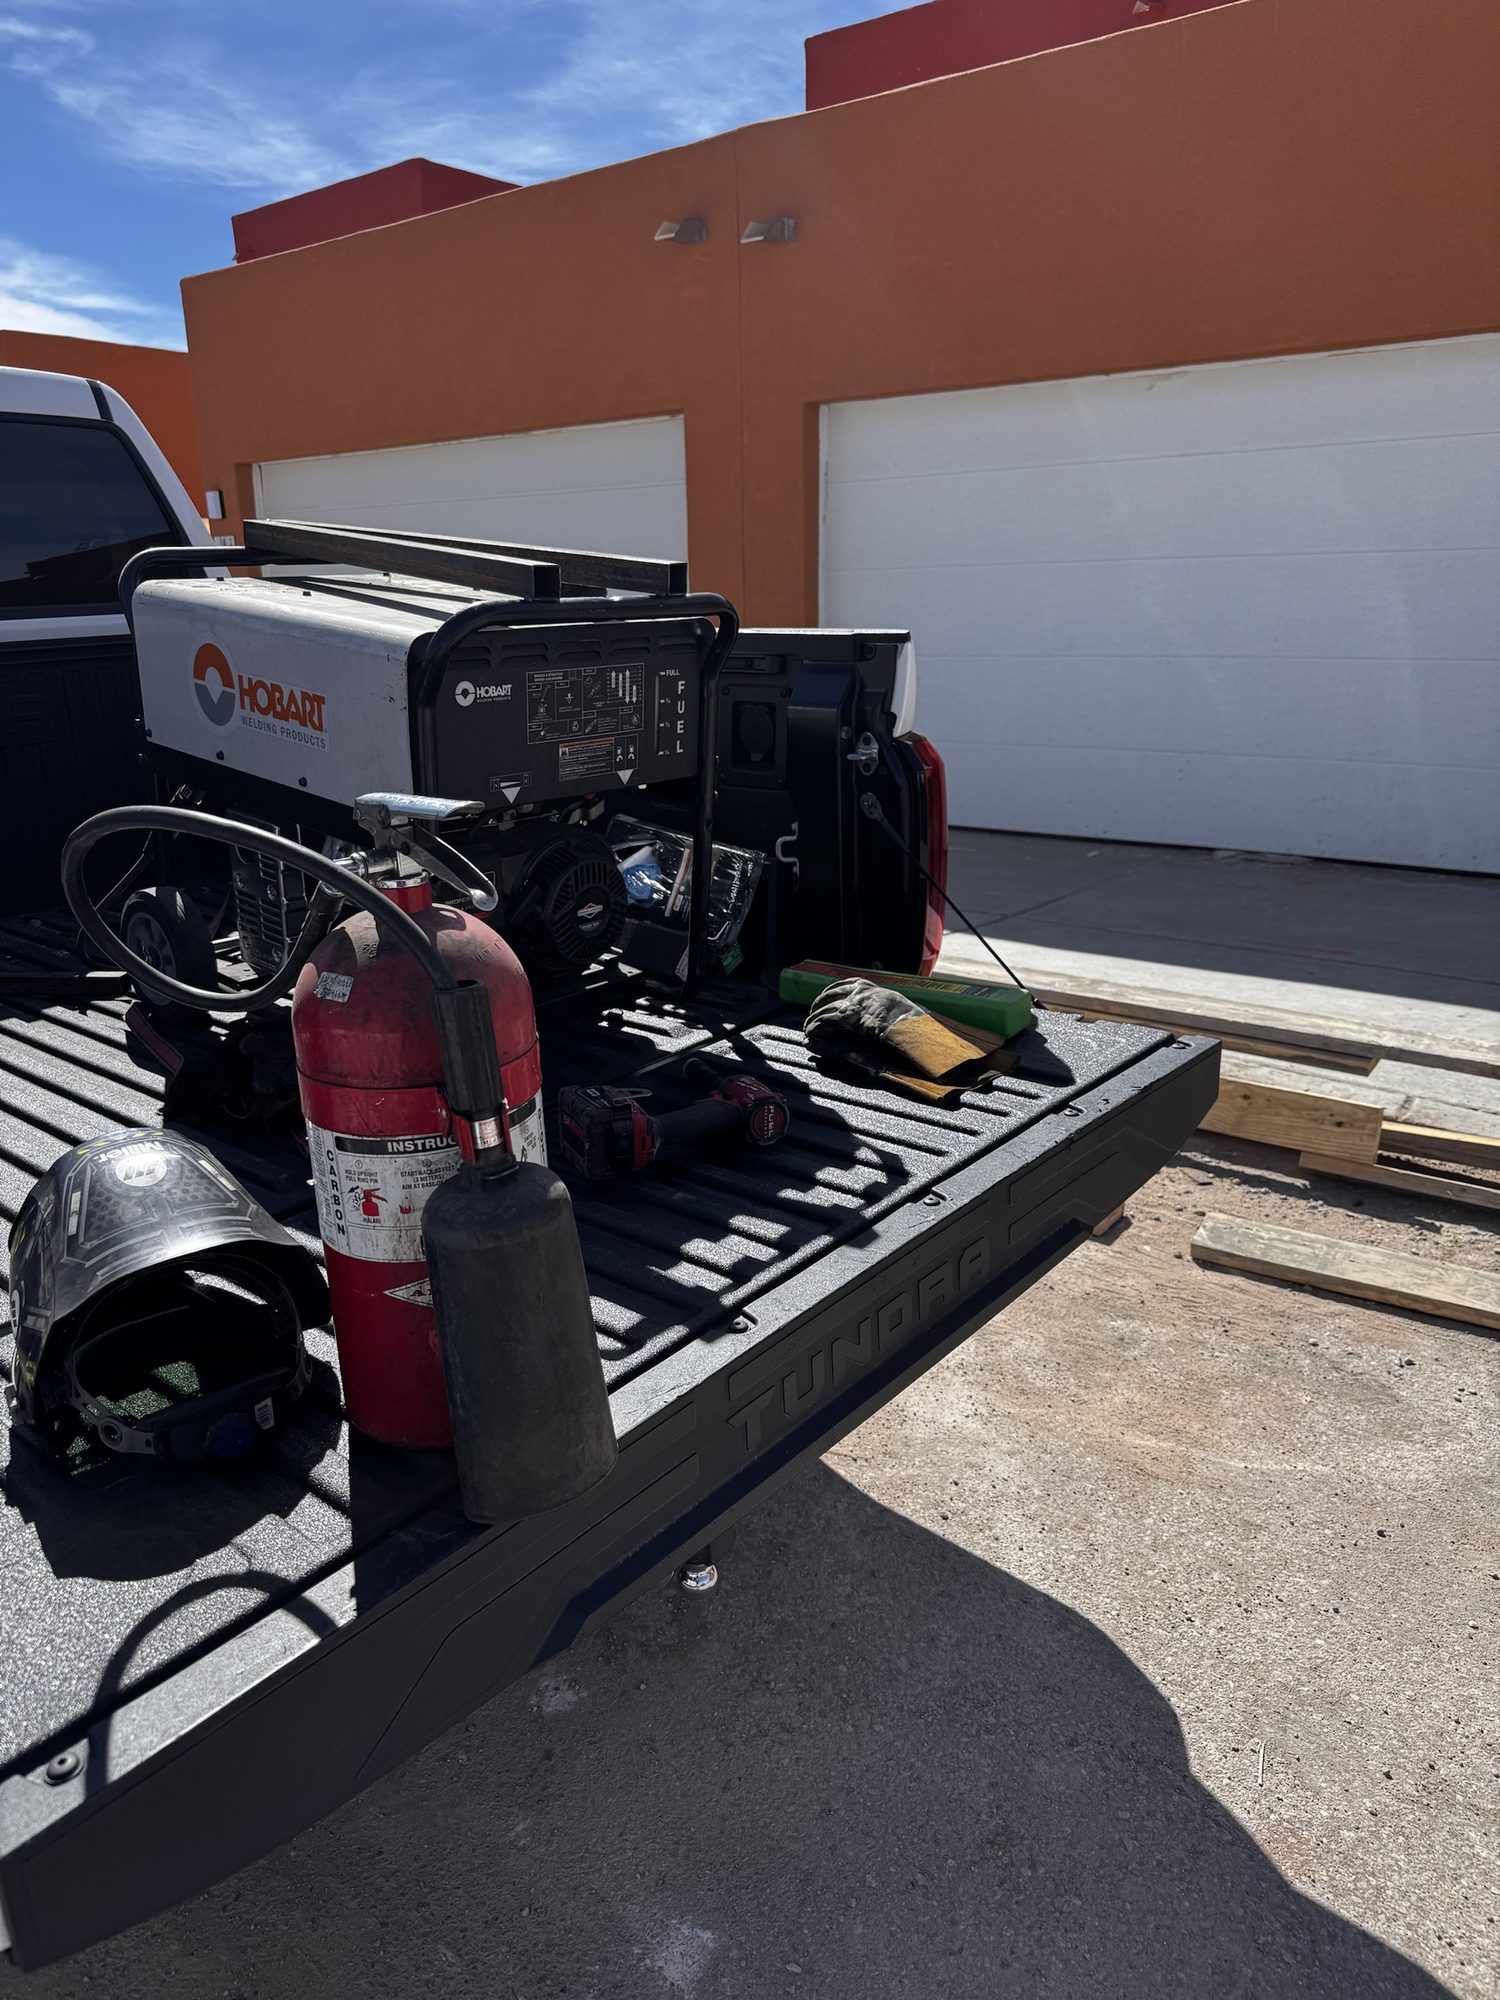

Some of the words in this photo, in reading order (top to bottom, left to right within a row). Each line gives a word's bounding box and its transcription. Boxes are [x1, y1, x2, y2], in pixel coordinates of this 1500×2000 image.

[476, 684, 512, 698] HOBART
[666, 669, 680, 677] FULL
[238, 674, 326, 732] HOBART
[676, 680, 686, 753] FUEL
[240, 715, 278, 735] WELDING
[279, 726, 326, 749] PRODUCTS
[387, 1137, 457, 1153] INSTRUC
[326, 1150, 345, 1236] CARBON
[726, 1236, 993, 1452] TUNDRA
